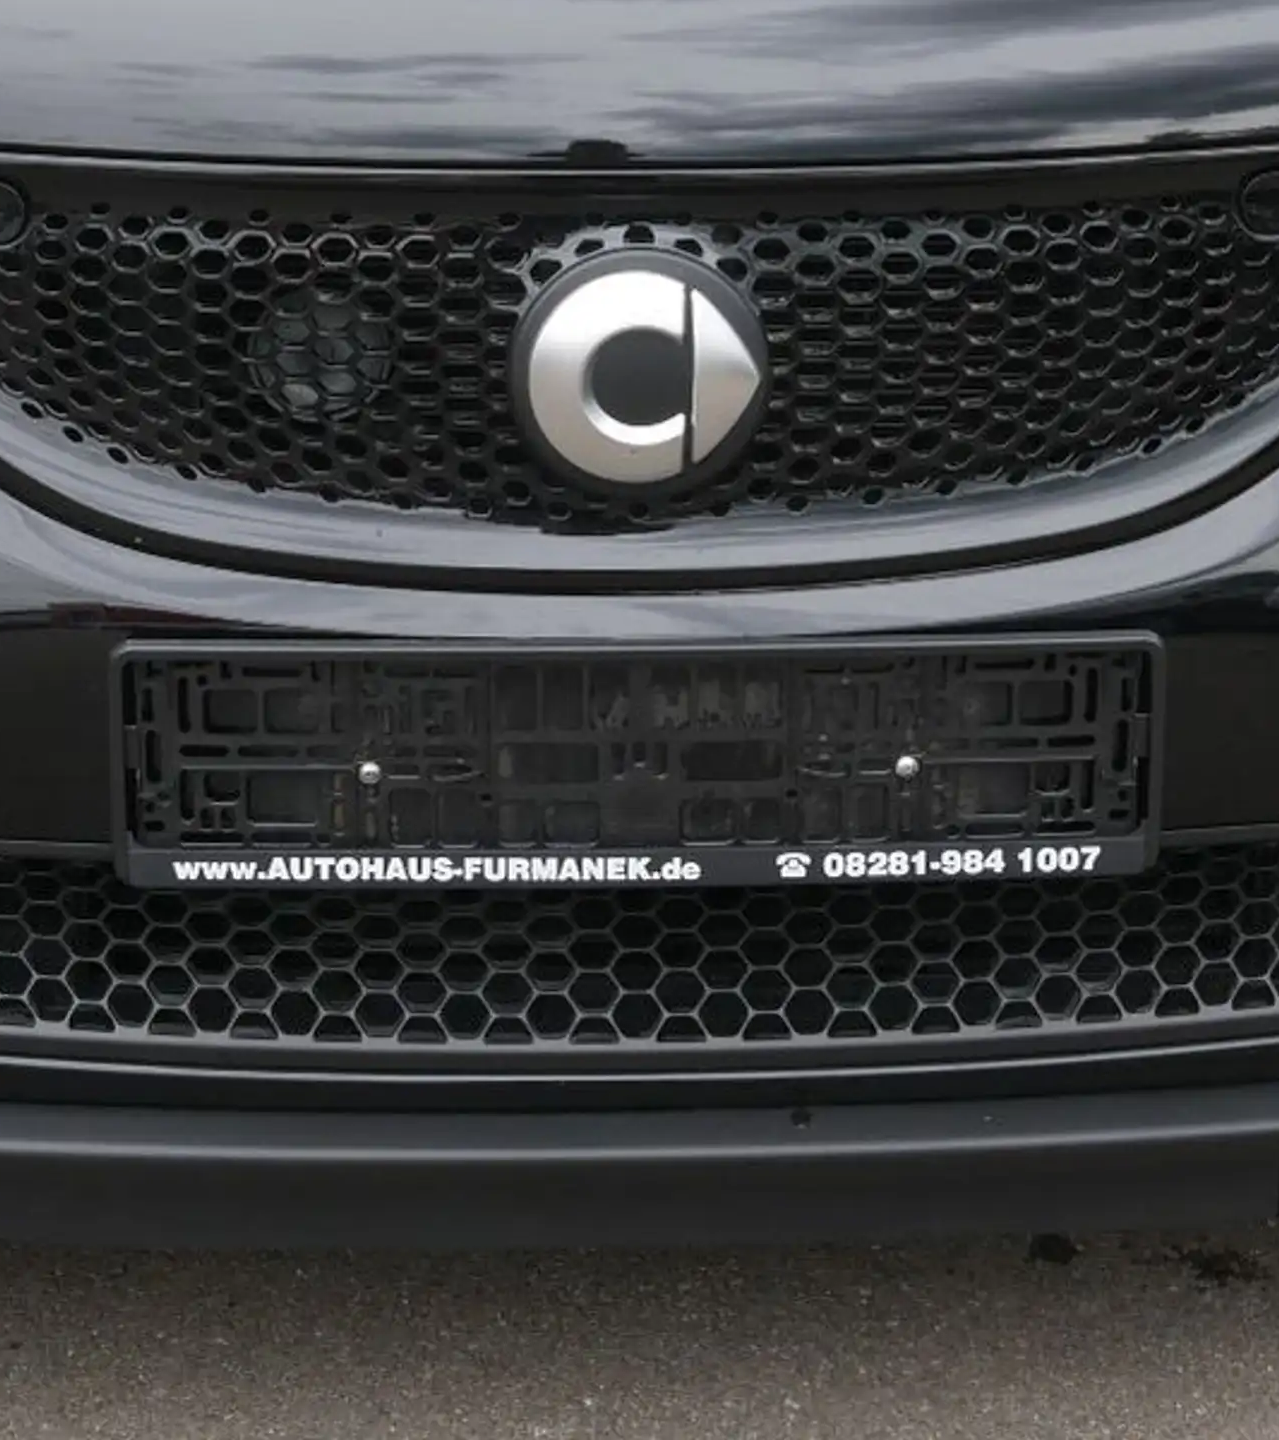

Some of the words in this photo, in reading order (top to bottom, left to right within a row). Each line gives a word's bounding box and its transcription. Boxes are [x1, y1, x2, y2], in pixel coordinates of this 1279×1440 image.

[173, 856, 700, 882] www.AUTOHAUS-FURMANEK.de
[822, 847, 1006, 878] 08281-984
[1018, 844, 1101, 874] 1007
